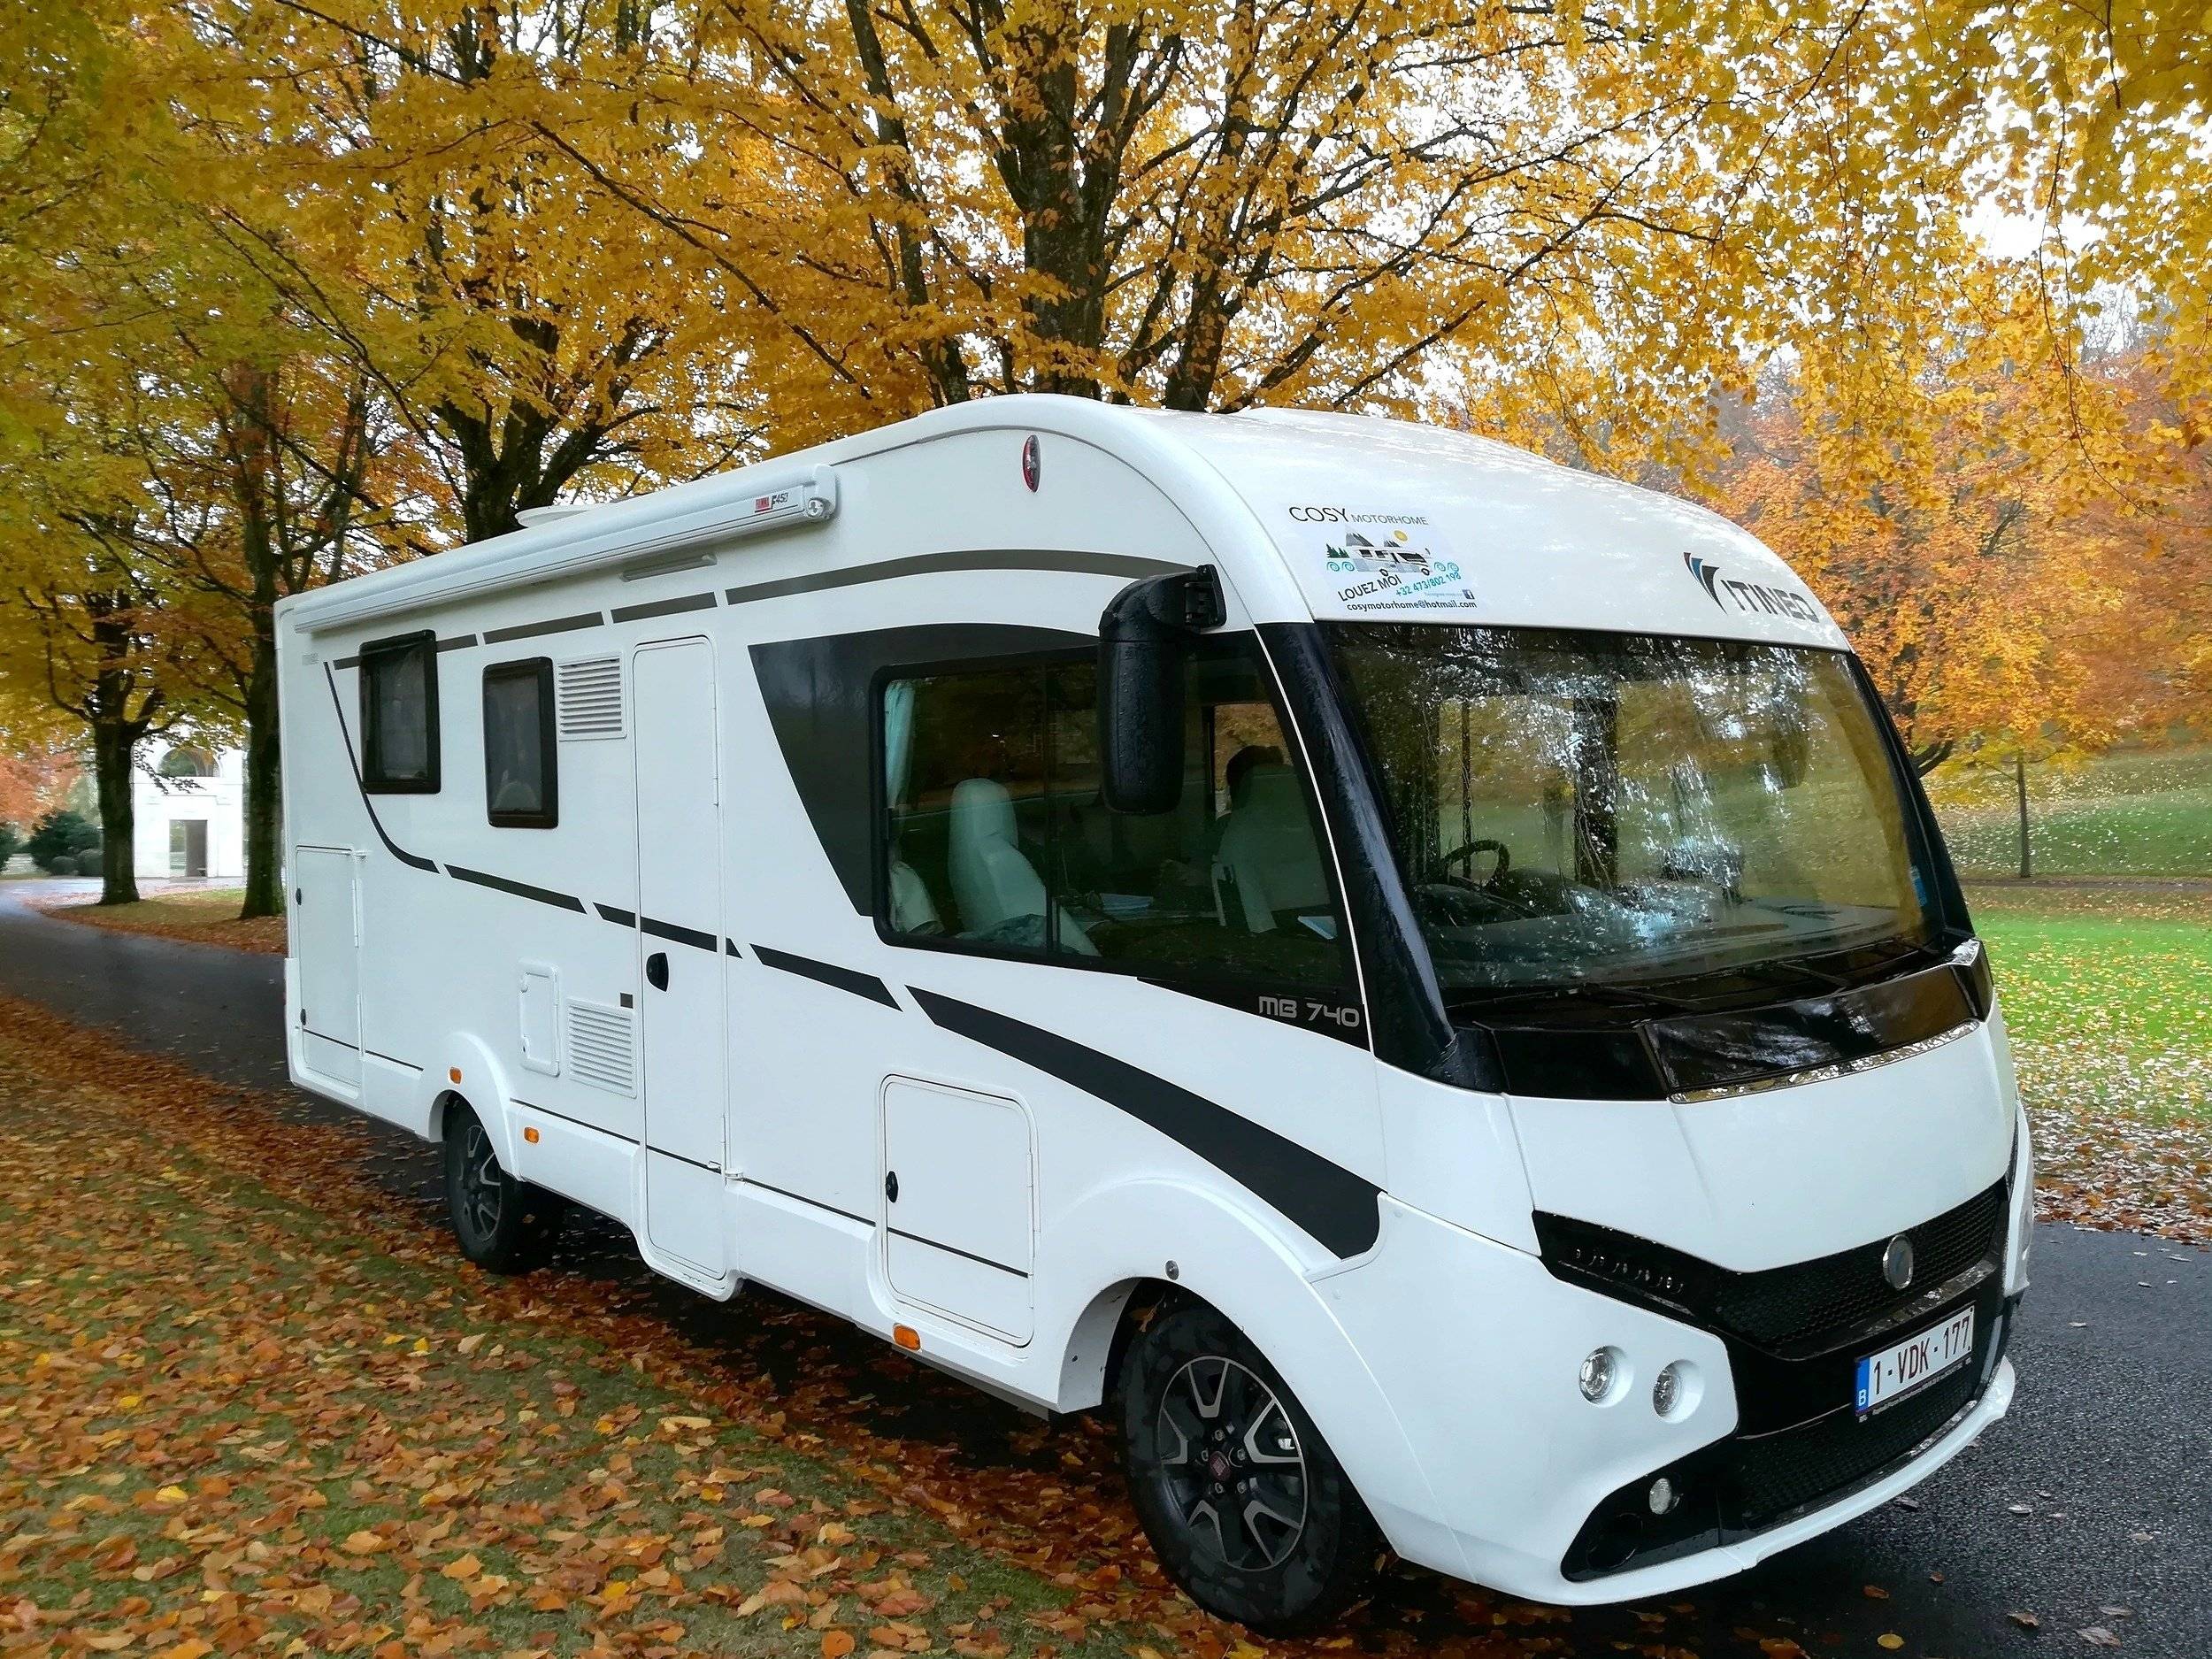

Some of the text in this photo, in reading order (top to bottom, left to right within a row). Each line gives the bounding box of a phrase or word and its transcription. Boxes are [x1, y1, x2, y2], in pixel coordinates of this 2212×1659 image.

[1288, 506, 1430, 526] COSY MOTORHOME
[1337, 573, 1402, 603] LOUEZ MOI
[1395, 585, 1412, 596] +32
[1413, 576, 1446, 592] 473/802
[1347, 599, 1478, 612] cosymotorhome@hotmail.com
[1258, 995, 1360, 1028] MB 740
[1858, 1388, 1867, 1407] B
